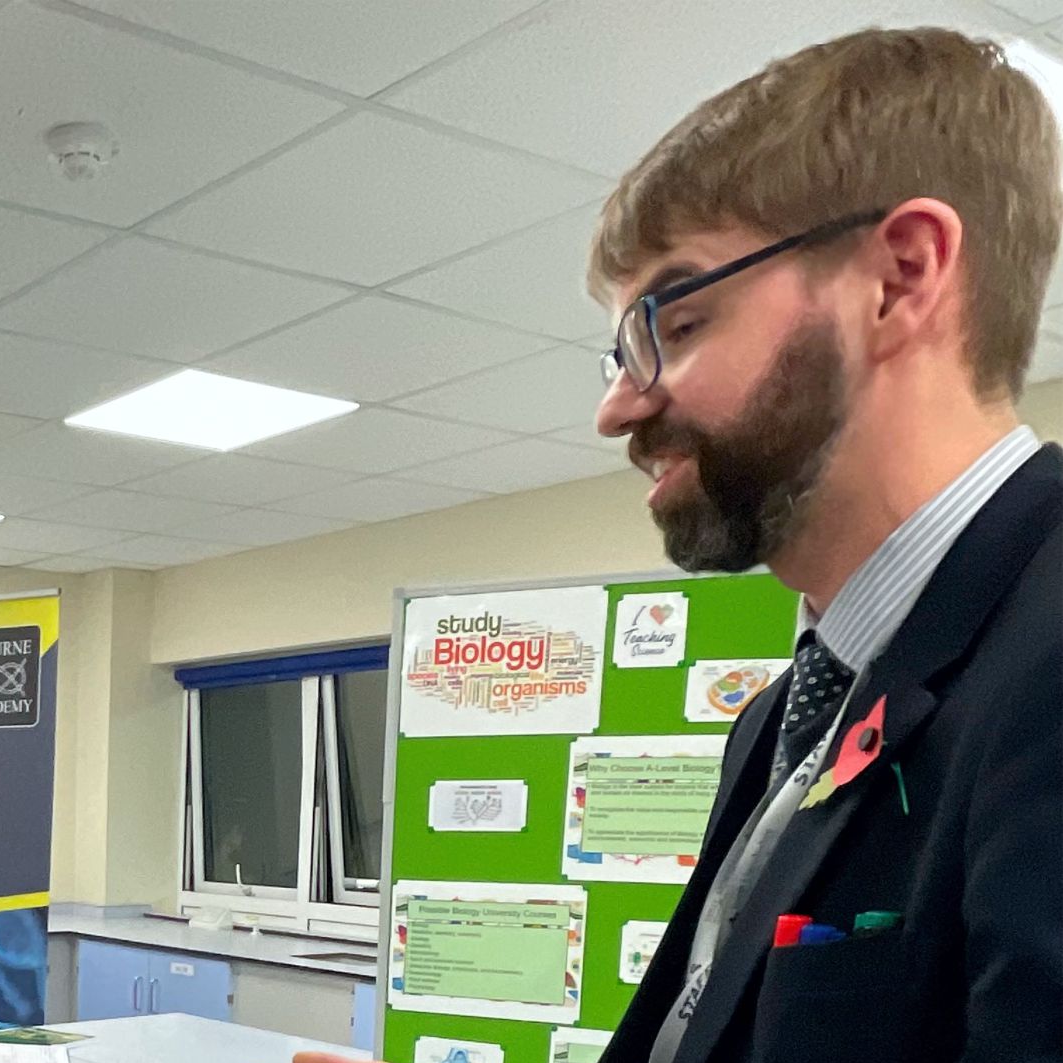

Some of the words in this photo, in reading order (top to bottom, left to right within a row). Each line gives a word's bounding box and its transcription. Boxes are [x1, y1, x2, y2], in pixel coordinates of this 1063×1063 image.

[436, 611, 502, 638] study
[623, 628, 676, 647] Teaching
[434, 636, 544, 671] Biology
[492, 680, 587, 701] organisms
[589, 764, 608, 773] Why
[610, 764, 644, 772] Choose
[646, 763, 680, 772] A-Level
[452, 906, 480, 917] Biology
[482, 908, 521, 919] University
[523, 909, 557, 919] Courses
